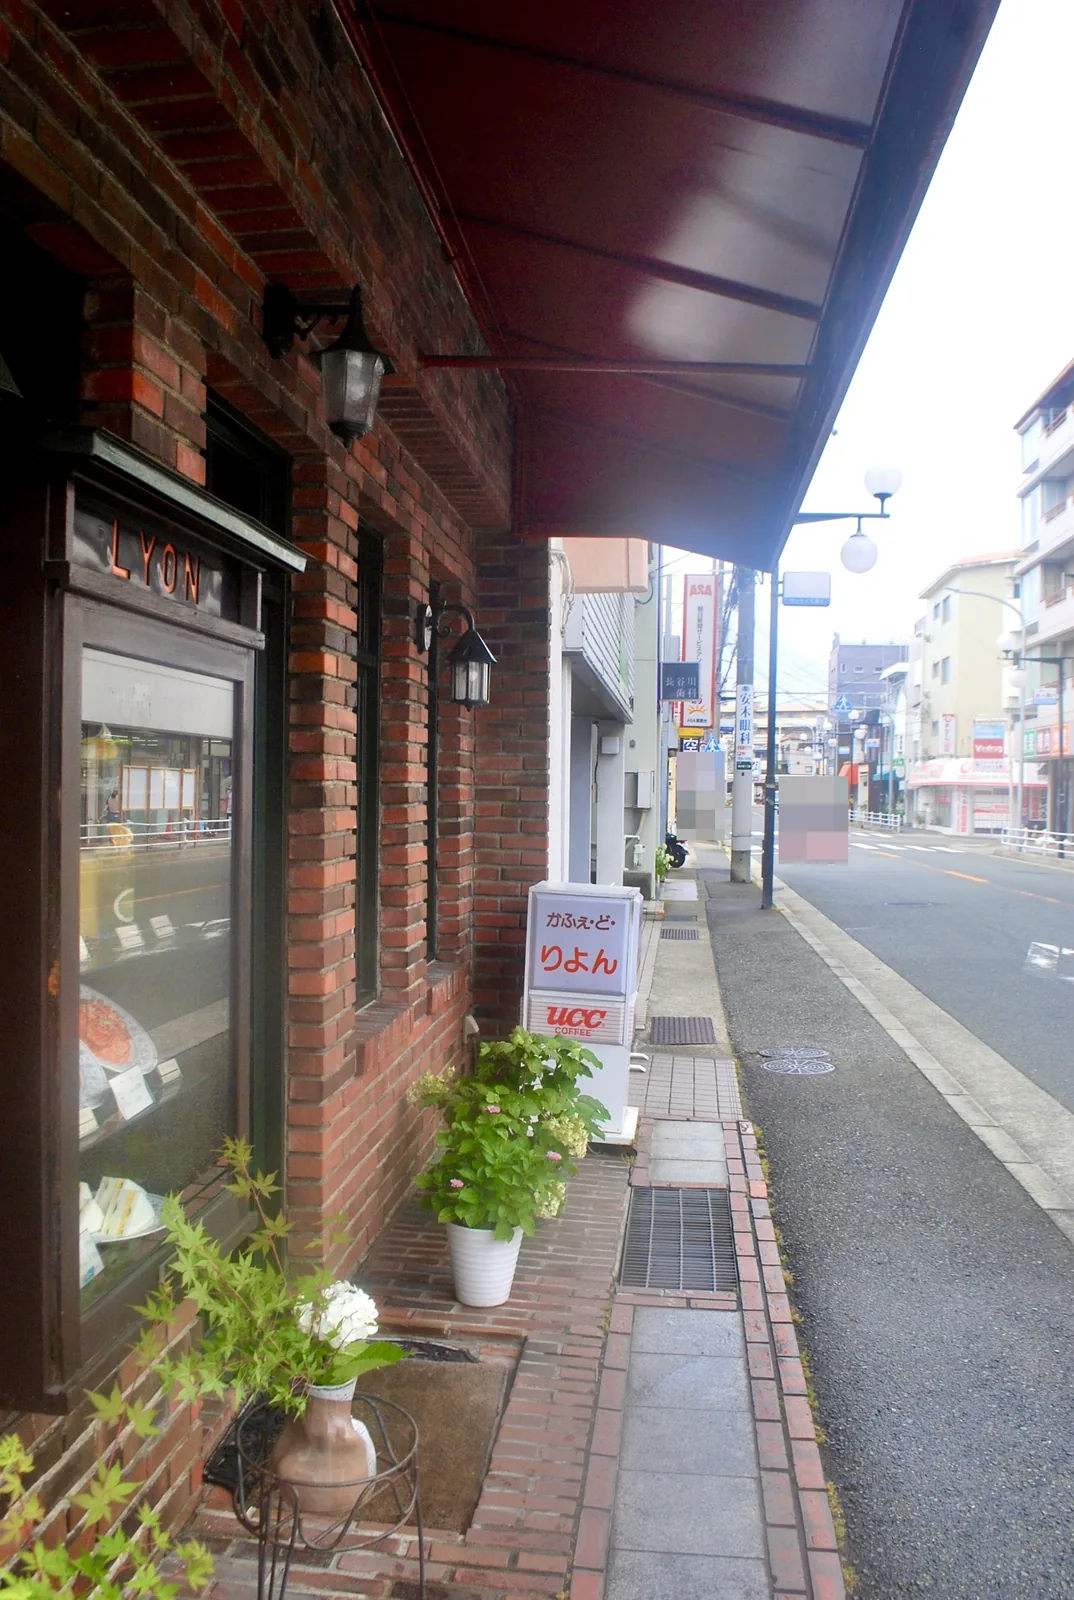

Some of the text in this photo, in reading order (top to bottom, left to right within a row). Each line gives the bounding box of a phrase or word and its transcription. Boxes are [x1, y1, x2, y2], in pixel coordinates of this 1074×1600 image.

[110, 519, 201, 606] LYON
[665, 676, 697, 687] 長谷川
[676, 688, 697, 699] 歯科
[541, 944, 618, 975] りよん
[555, 1027, 592, 1037] COFFEE
